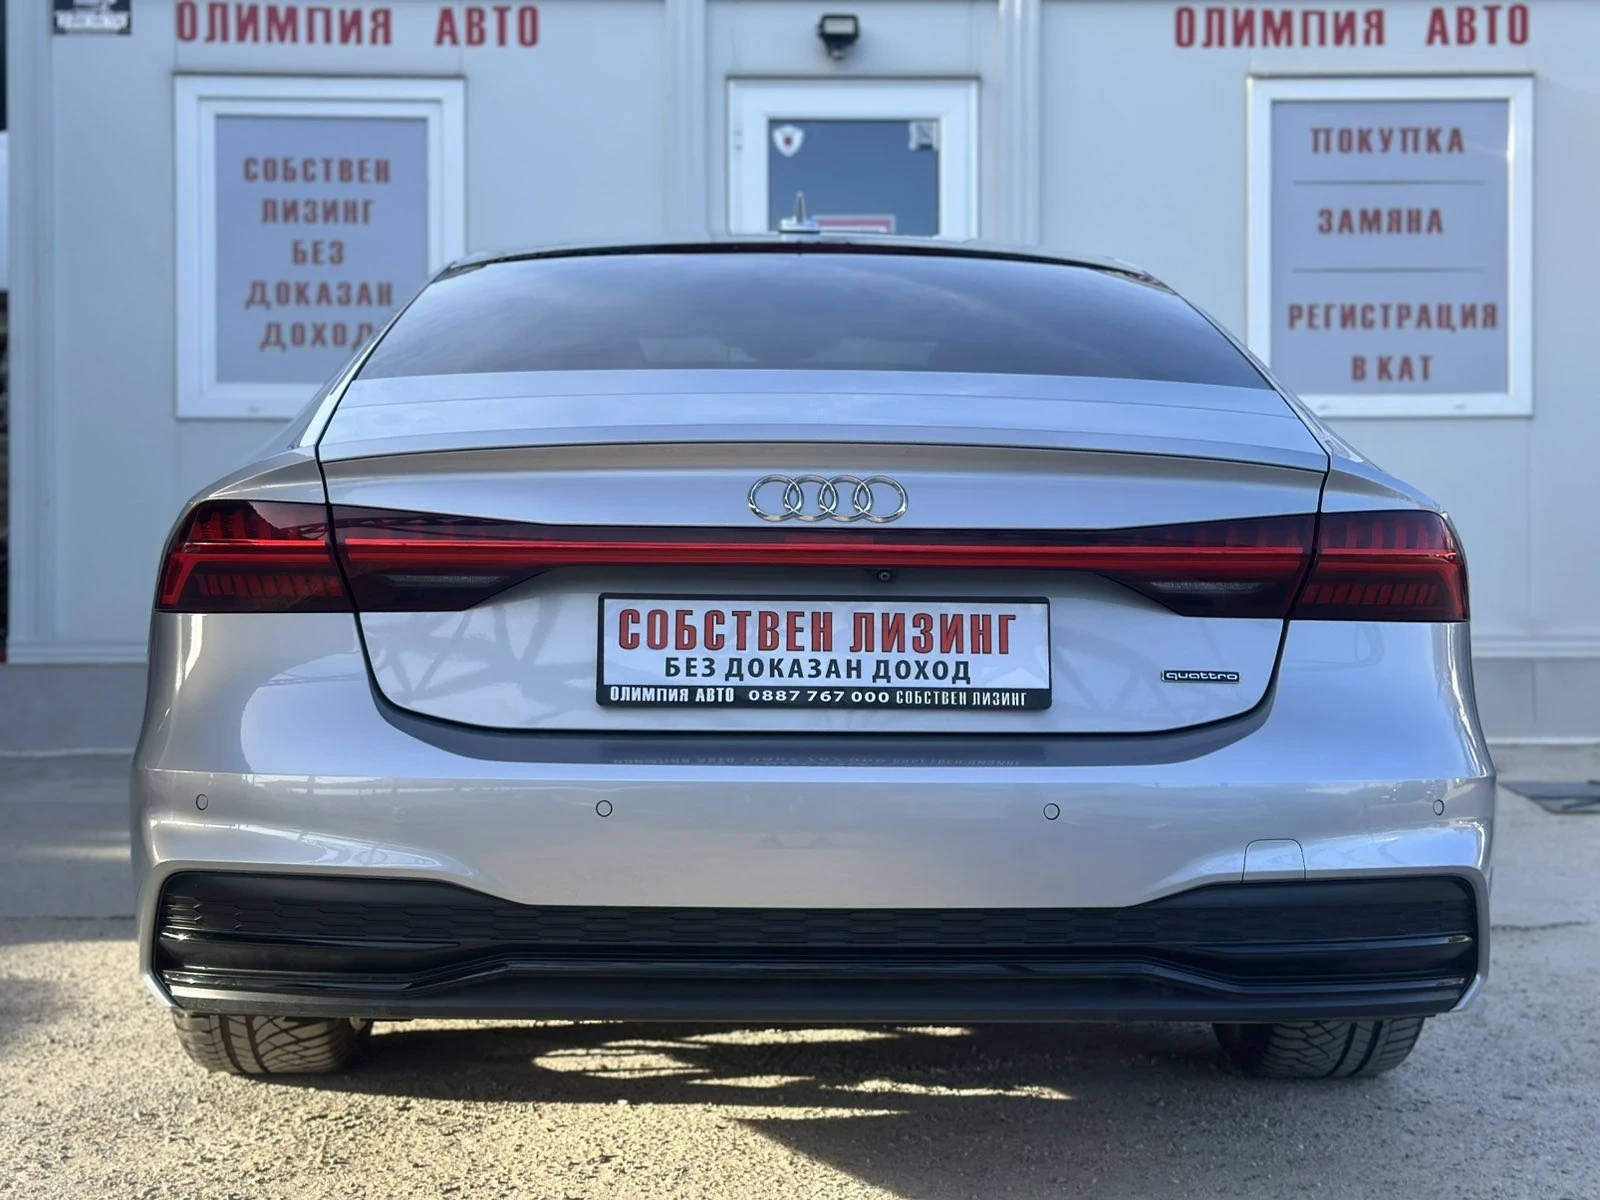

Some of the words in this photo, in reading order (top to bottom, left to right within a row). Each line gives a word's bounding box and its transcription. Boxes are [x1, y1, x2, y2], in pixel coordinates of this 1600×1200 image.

[176, 1, 392, 46] ОЛИМПИЯ
[435, 6, 540, 47] АВТО
[1175, 6, 1385, 48] ОЛИМПИЯ
[1426, 5, 1530, 46] АВТО
[1311, 127, 1465, 154] ПОКУПКА
[243, 157, 391, 184] СОБСТВЕН
[261, 198, 376, 224] ЛИЗИНГ
[1318, 208, 1444, 235] ЗАМЯНА
[292, 240, 345, 266] БЕЗ
[244, 281, 393, 310] ДОКАЗАН
[1288, 303, 1498, 332] РЕГИСТРАЦИЯ
[1351, 355, 1367, 382] В
[1377, 354, 1433, 382] КАТ
[618, 608, 832, 653] СОБСТВЕН
[849, 611, 1017, 655] ЛИЗИНГ
[665, 656, 716, 678] БЕЗ
[725, 657, 862, 682] ДОКАЗАН
[872, 659, 971, 685] ДОХОД
[1166, 672, 1238, 681] quattro
[610, 686, 689, 702] ОЛИМПИЯ
[695, 687, 735, 703] АВТО
[748, 690, 800, 702] 0887
[807, 690, 844, 703] 767
[851, 691, 890, 703] 000
[896, 690, 967, 706] СОБСТВЕН
[972, 692, 1027, 706] ЛИЗИНГ
